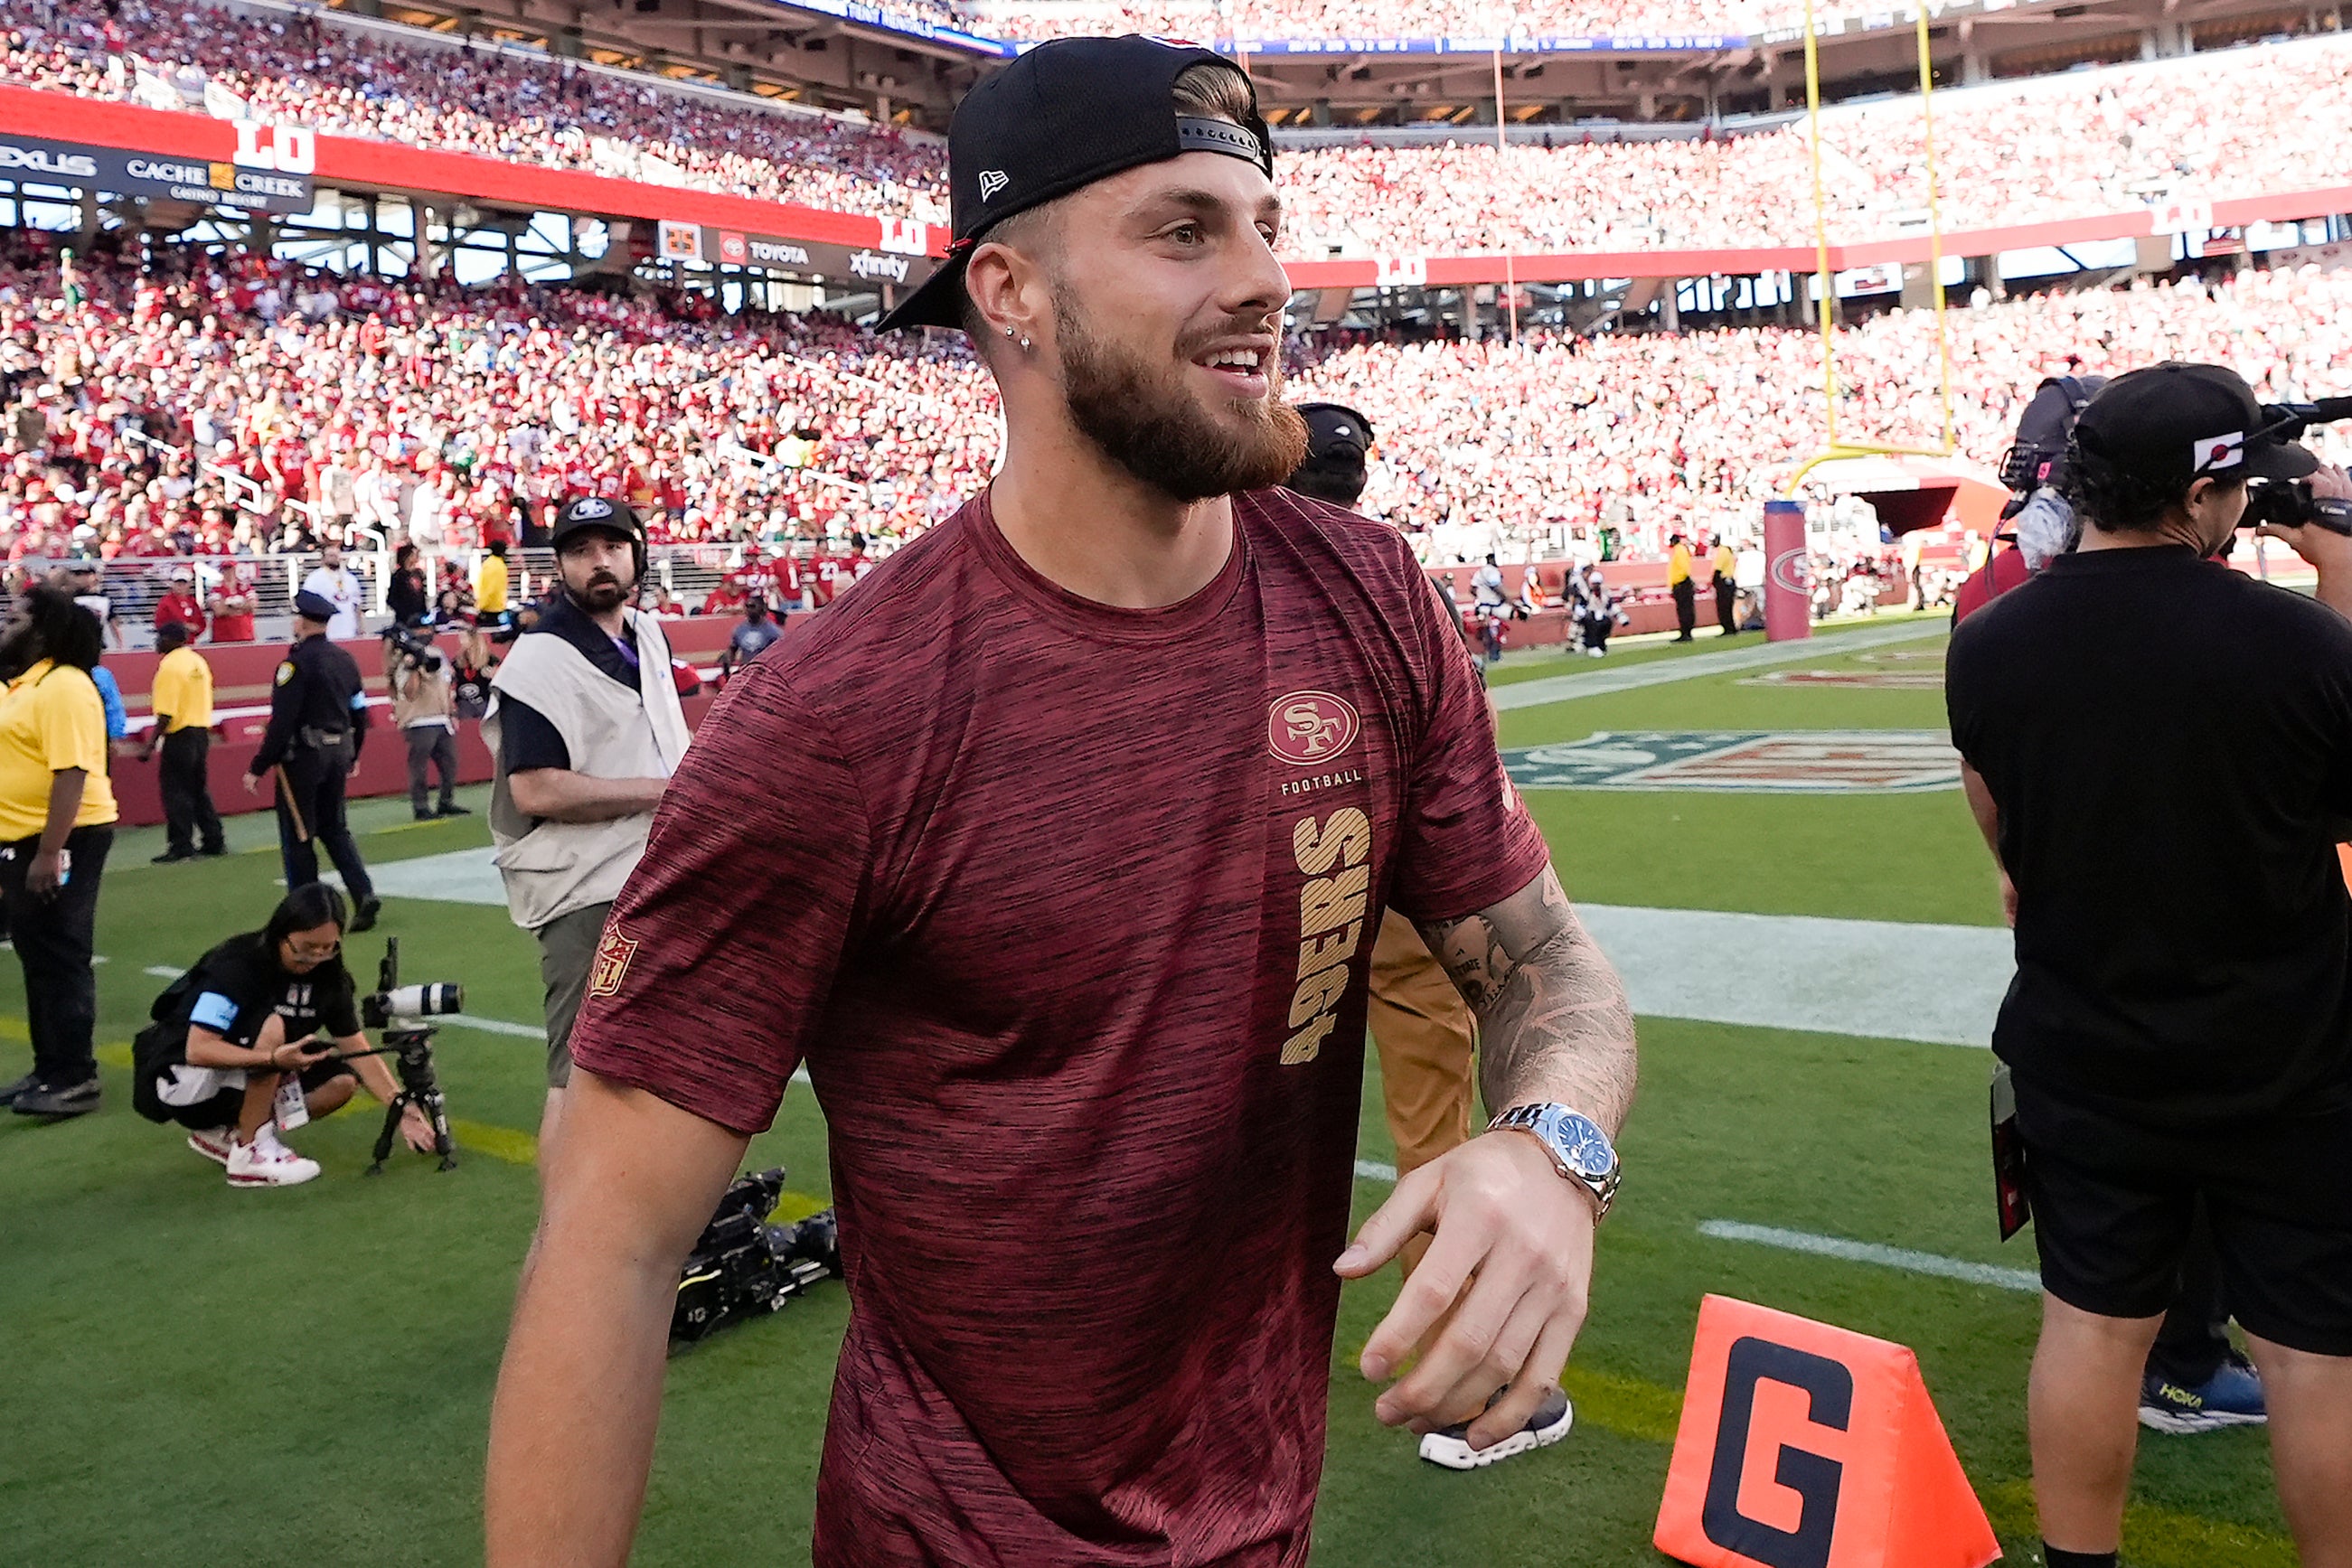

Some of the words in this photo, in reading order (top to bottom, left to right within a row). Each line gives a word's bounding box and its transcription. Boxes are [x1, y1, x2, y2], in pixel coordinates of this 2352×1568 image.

[232, 119, 315, 174] LO
[127, 159, 207, 185] CACHE
[235, 173, 305, 198] CREEK
[749, 241, 810, 265] TOYOTA
[849, 249, 909, 283] xfinity
[1282, 769, 1362, 796] FOOTBALL
[1279, 806, 1371, 1066] 49ERS
[2159, 1383, 2203, 1409] HOKA
[1702, 1336, 1854, 1568] G
